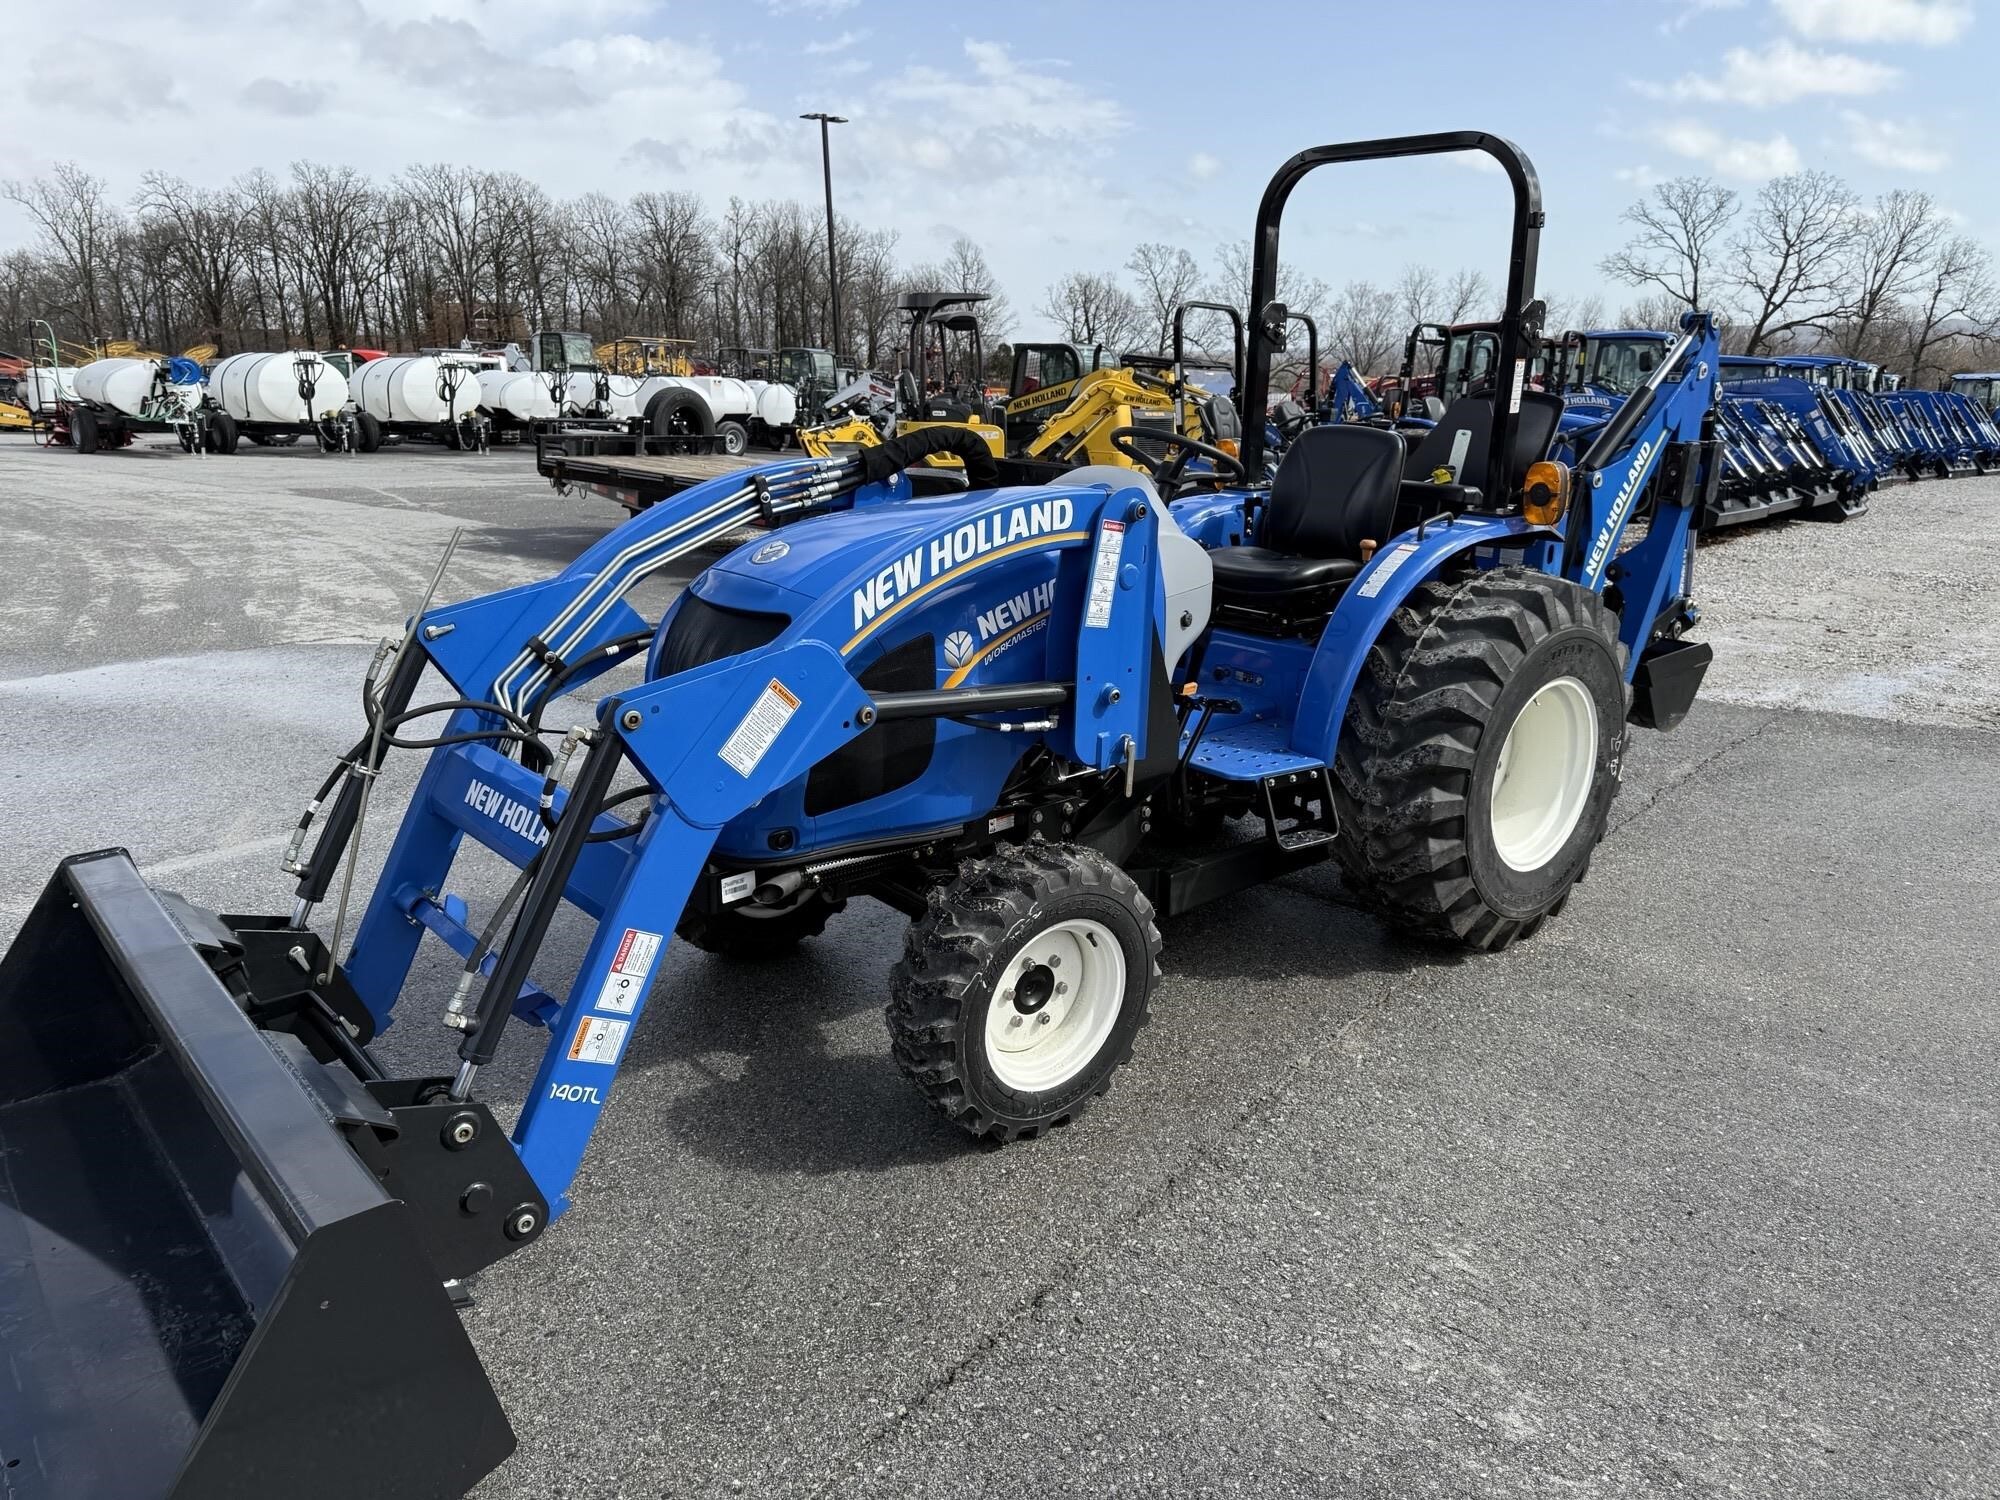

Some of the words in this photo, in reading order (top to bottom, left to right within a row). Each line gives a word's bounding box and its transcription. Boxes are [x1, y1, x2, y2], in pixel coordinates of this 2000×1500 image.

[1013, 398, 1031, 411] NEW
[1031, 387, 1067, 405] HOLLAND
[1570, 396, 1610, 406] HOLLAND
[1585, 527, 1611, 577] NEW
[1605, 441, 1651, 528] HOLLAND
[853, 546, 924, 631] NEW
[930, 498, 1074, 577] HOLLAND
[976, 591, 1032, 641] NEW
[984, 618, 1047, 666] WORKMASTER
[464, 778, 505, 819] NEW
[618, 931, 635, 961] DANGER
[576, 1021, 589, 1048] WARNING
[549, 1082, 601, 1105] 140TL
